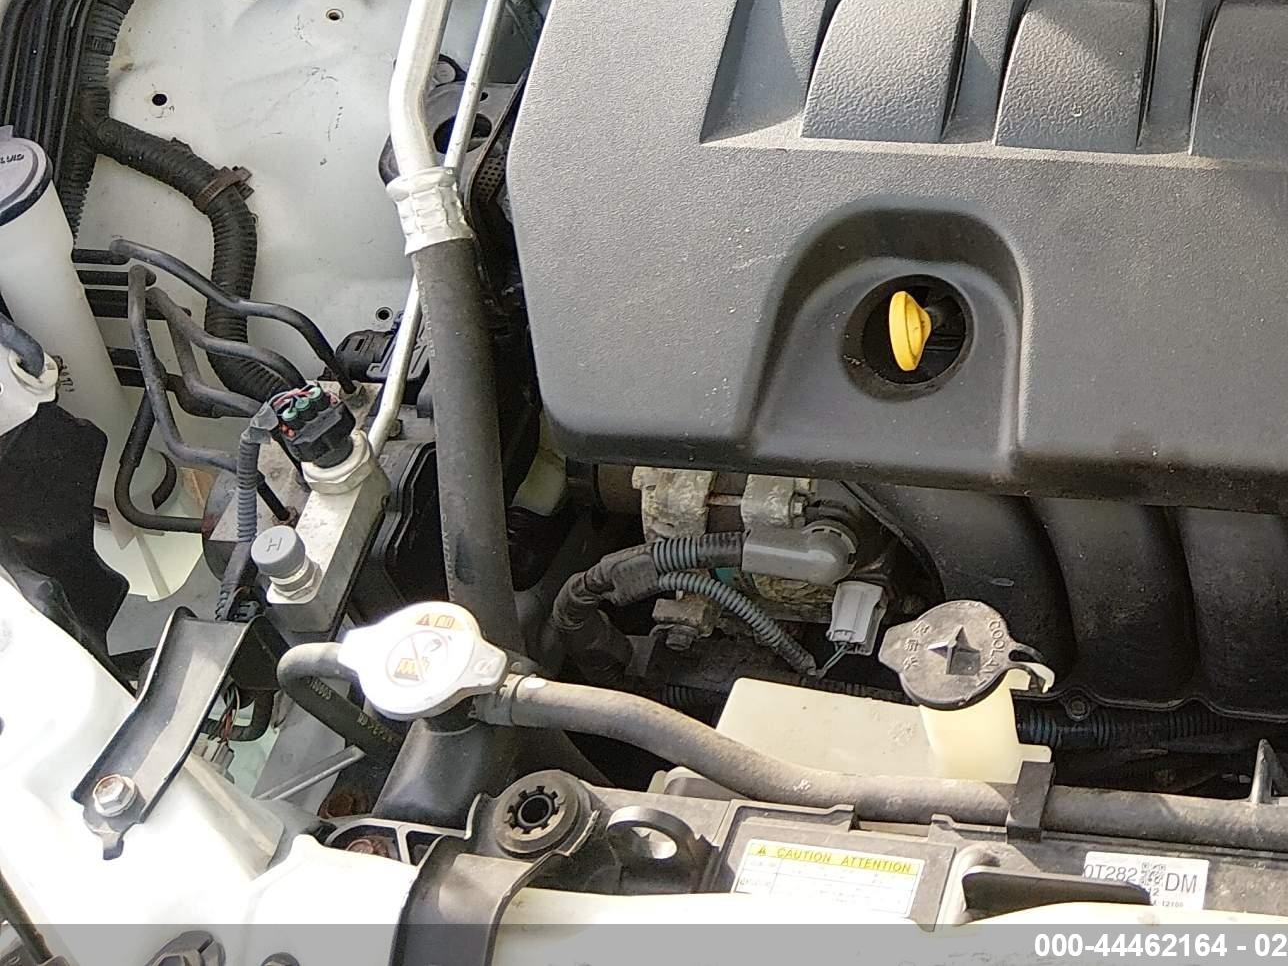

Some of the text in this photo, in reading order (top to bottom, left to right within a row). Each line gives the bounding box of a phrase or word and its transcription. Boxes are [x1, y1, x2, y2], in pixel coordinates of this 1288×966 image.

[776, 847, 913, 873] CAUTION ATTENTION
[1165, 872, 1198, 894] DM
